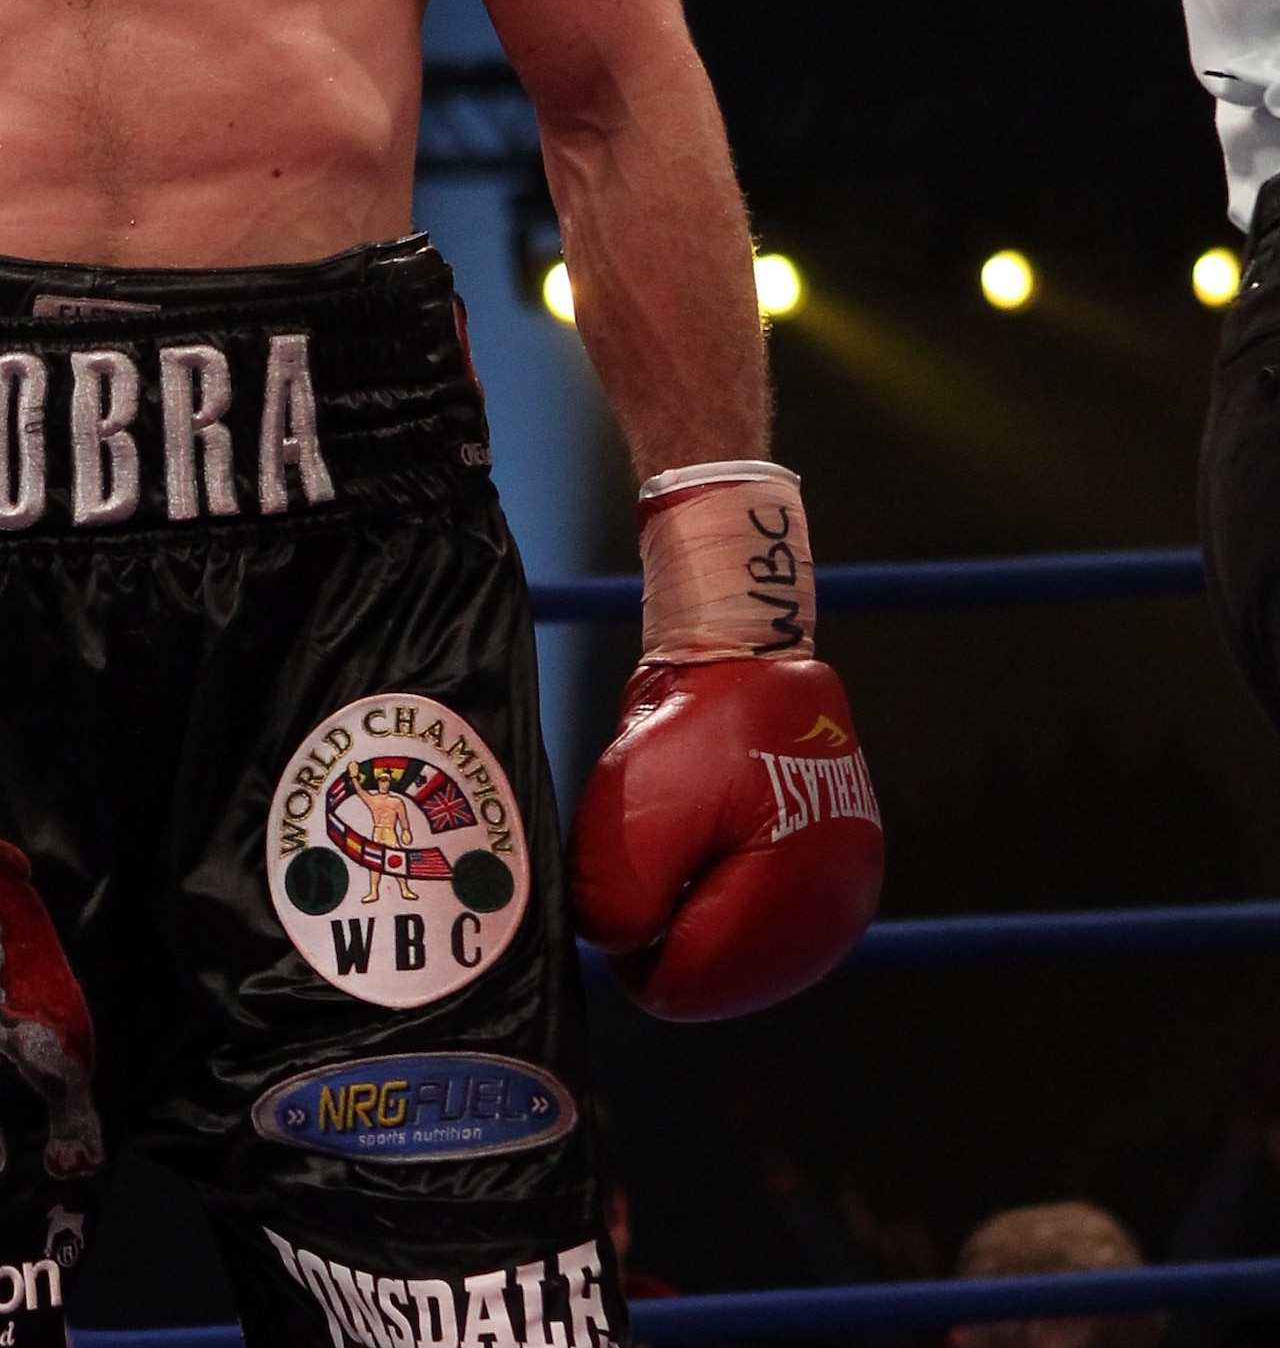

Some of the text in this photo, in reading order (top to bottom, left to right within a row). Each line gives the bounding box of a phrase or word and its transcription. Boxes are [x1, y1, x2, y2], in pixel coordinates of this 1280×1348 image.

[748, 506, 804, 655] WBC
[280, 707, 513, 858] WORLD CHAMPION
[358, 1126, 483, 1147] sports nutrition
